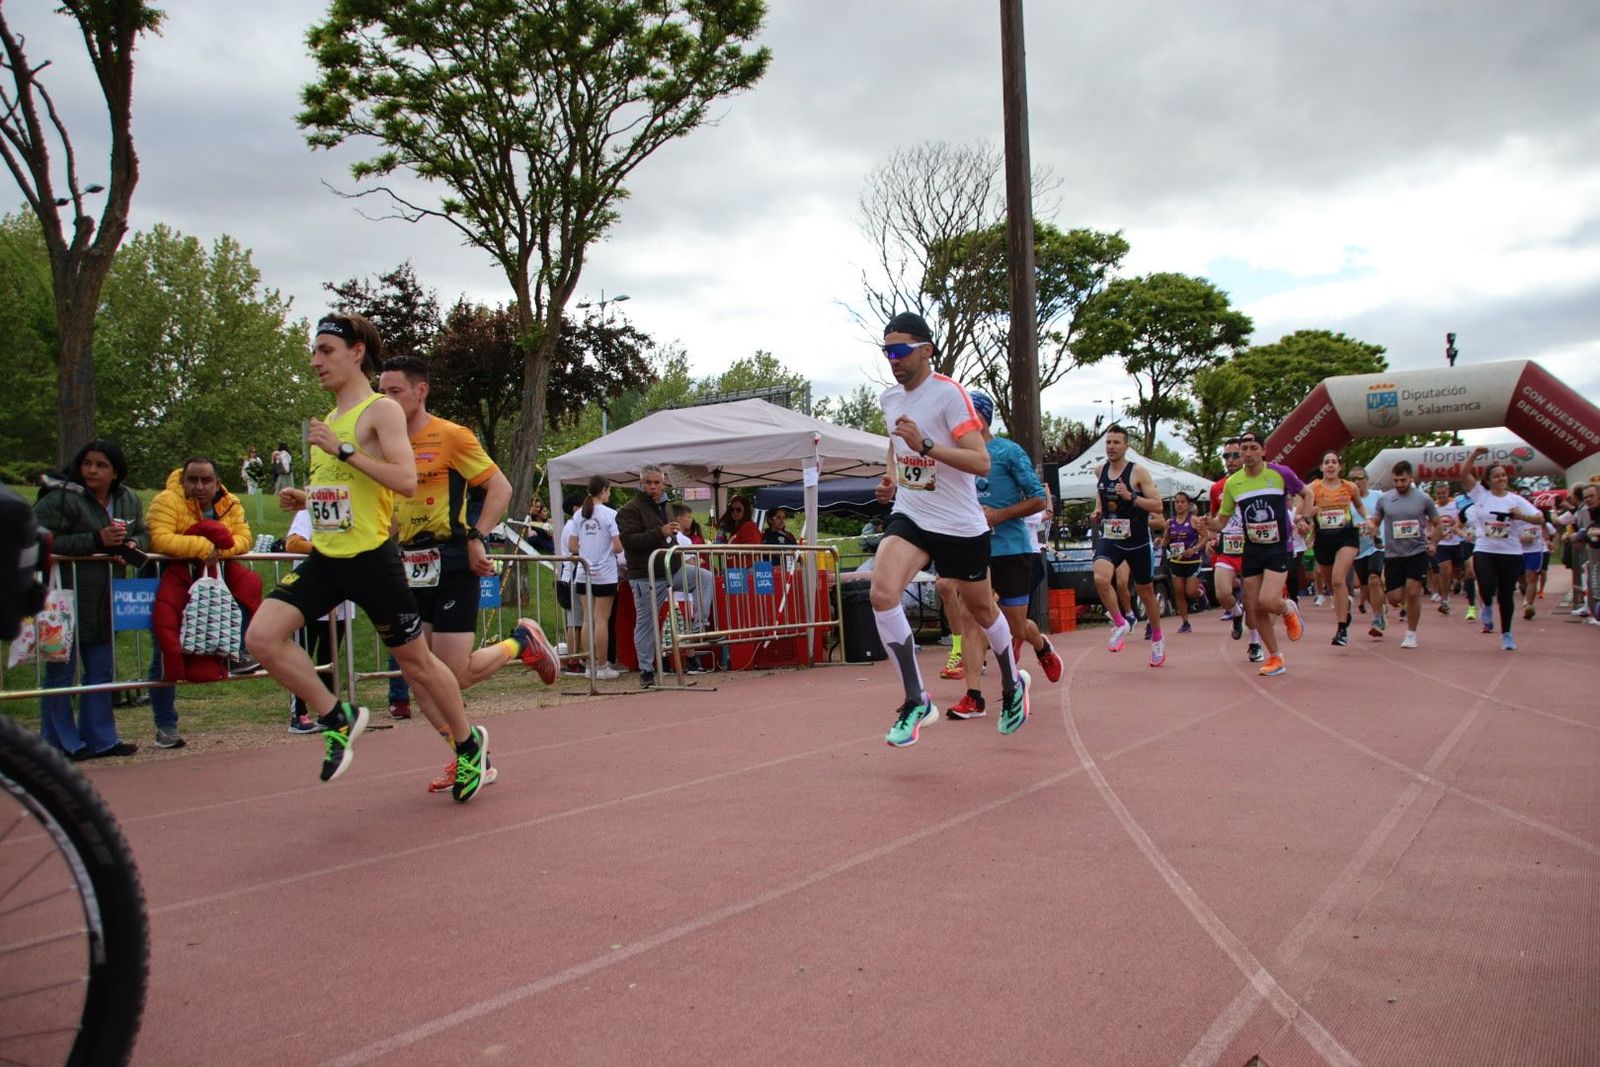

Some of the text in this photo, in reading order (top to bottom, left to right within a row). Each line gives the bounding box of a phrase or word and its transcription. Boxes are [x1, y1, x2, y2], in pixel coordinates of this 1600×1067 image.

[1402, 385, 1466, 402] Diputación
[1403, 401, 1481, 416] de Salamanca
[1522, 386, 1600, 444] CON NUESTROS
[1283, 443, 1296, 454] EL
[1294, 403, 1333, 442] DEPORTE
[1516, 400, 1586, 452] DEPORTISTAS
[904, 465, 922, 482] 49
[1417, 463, 1516, 479] beda
[312, 501, 340, 520] 561
[1326, 516, 1338, 525] 21
[1111, 525, 1123, 534] 44
[1255, 530, 1270, 539] 95
[412, 563, 429, 578] 67
[114, 591, 156, 602] POLICIA
[480, 589, 494, 598] CAL
[116, 604, 152, 615] LOCAL
